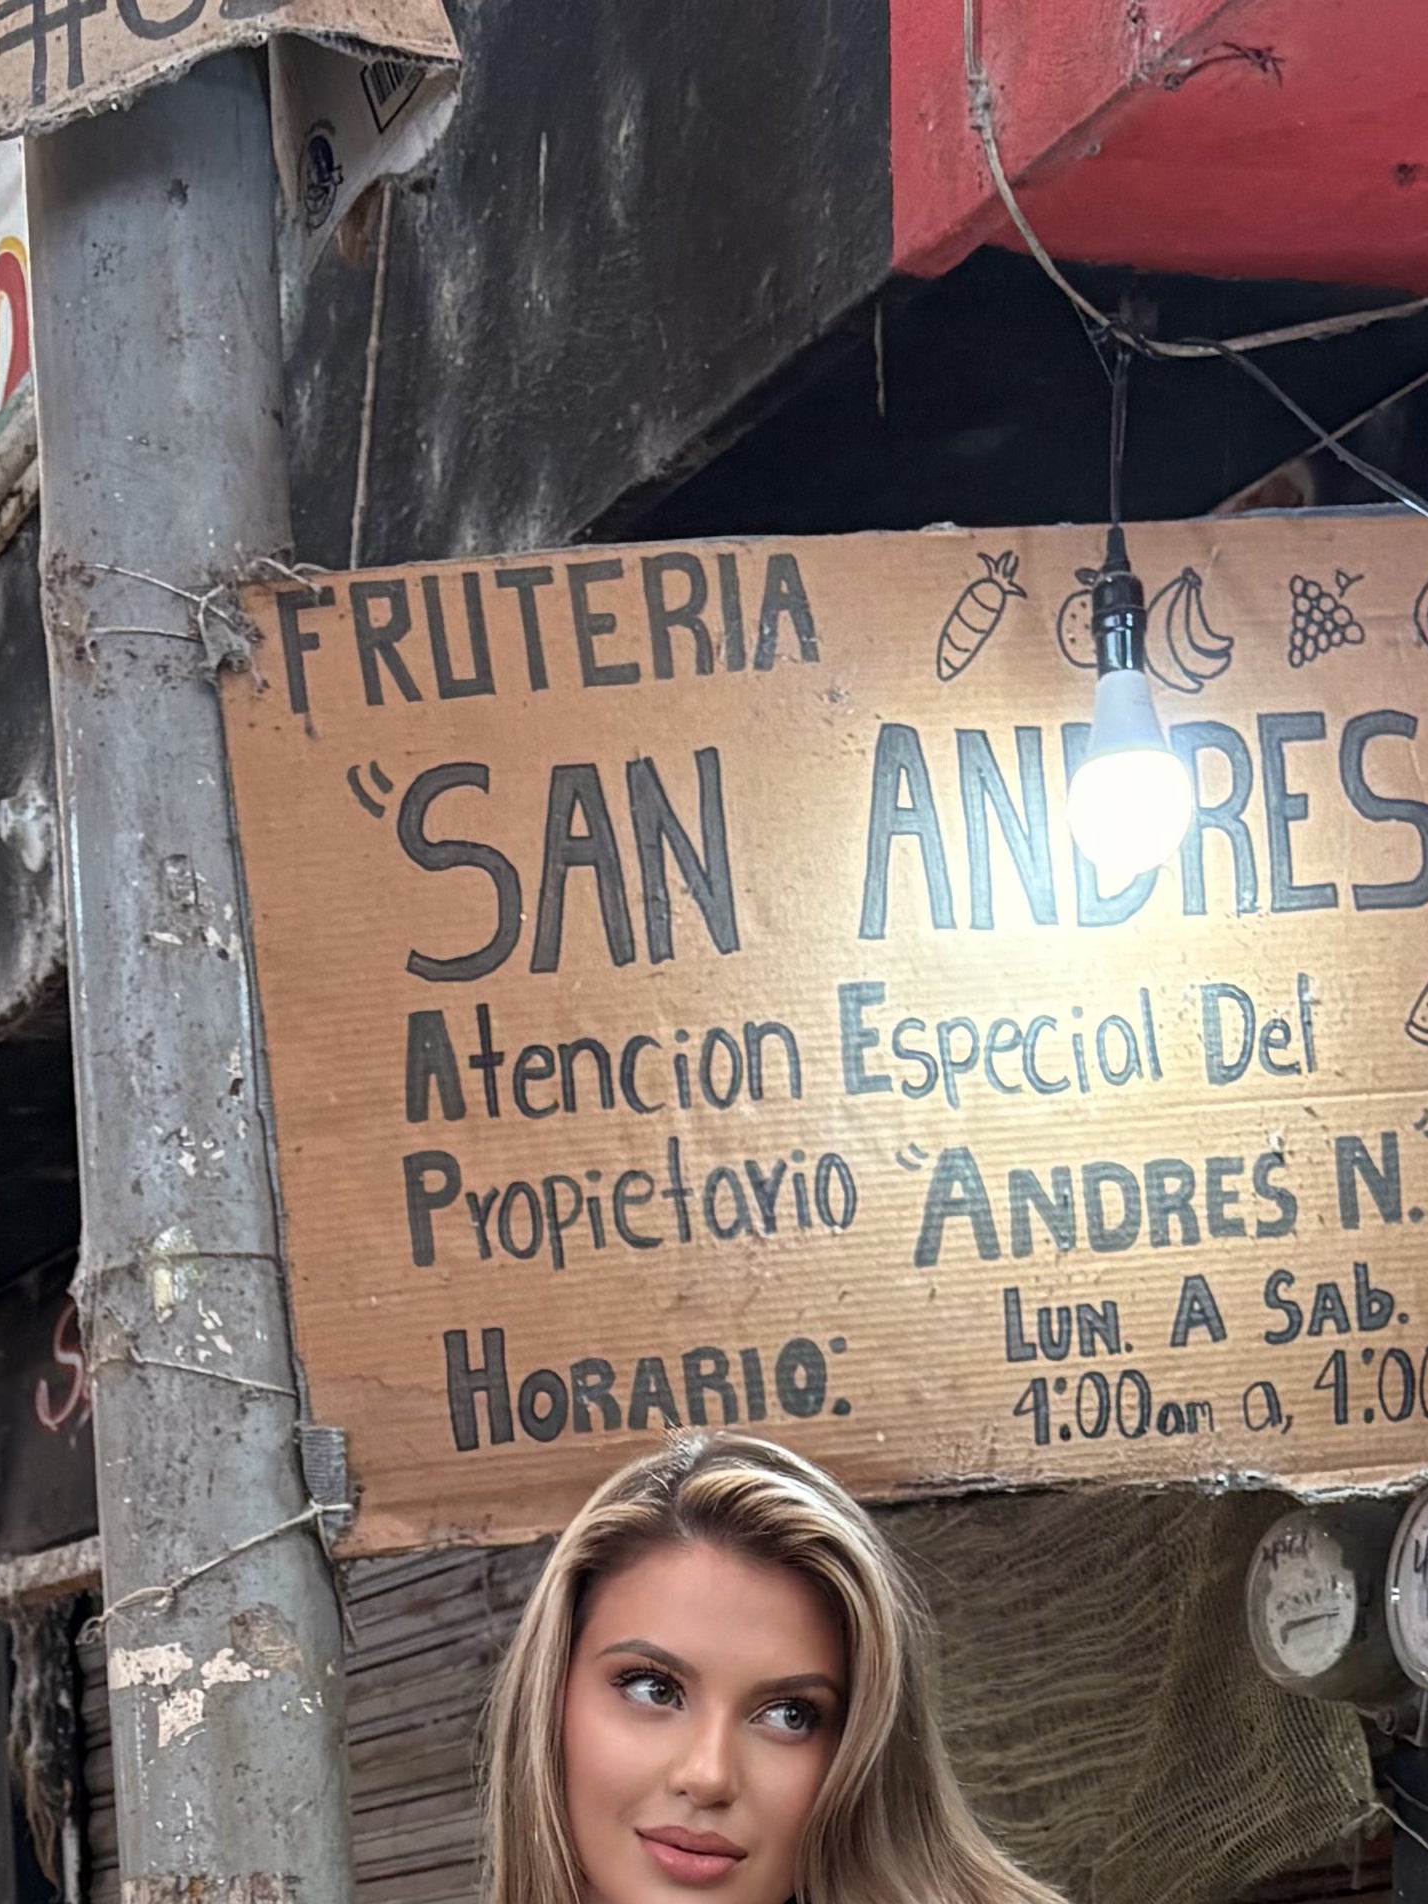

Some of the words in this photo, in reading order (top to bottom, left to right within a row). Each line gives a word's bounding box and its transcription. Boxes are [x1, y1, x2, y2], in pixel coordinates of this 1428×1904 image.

[275, 553, 820, 717] FRUTERIA
[405, 1003, 802, 1124] Atencion
[836, 981, 1162, 1109] Especial
[1199, 972, 1317, 1087] Del
[1170, 1274, 1227, 1347] A
